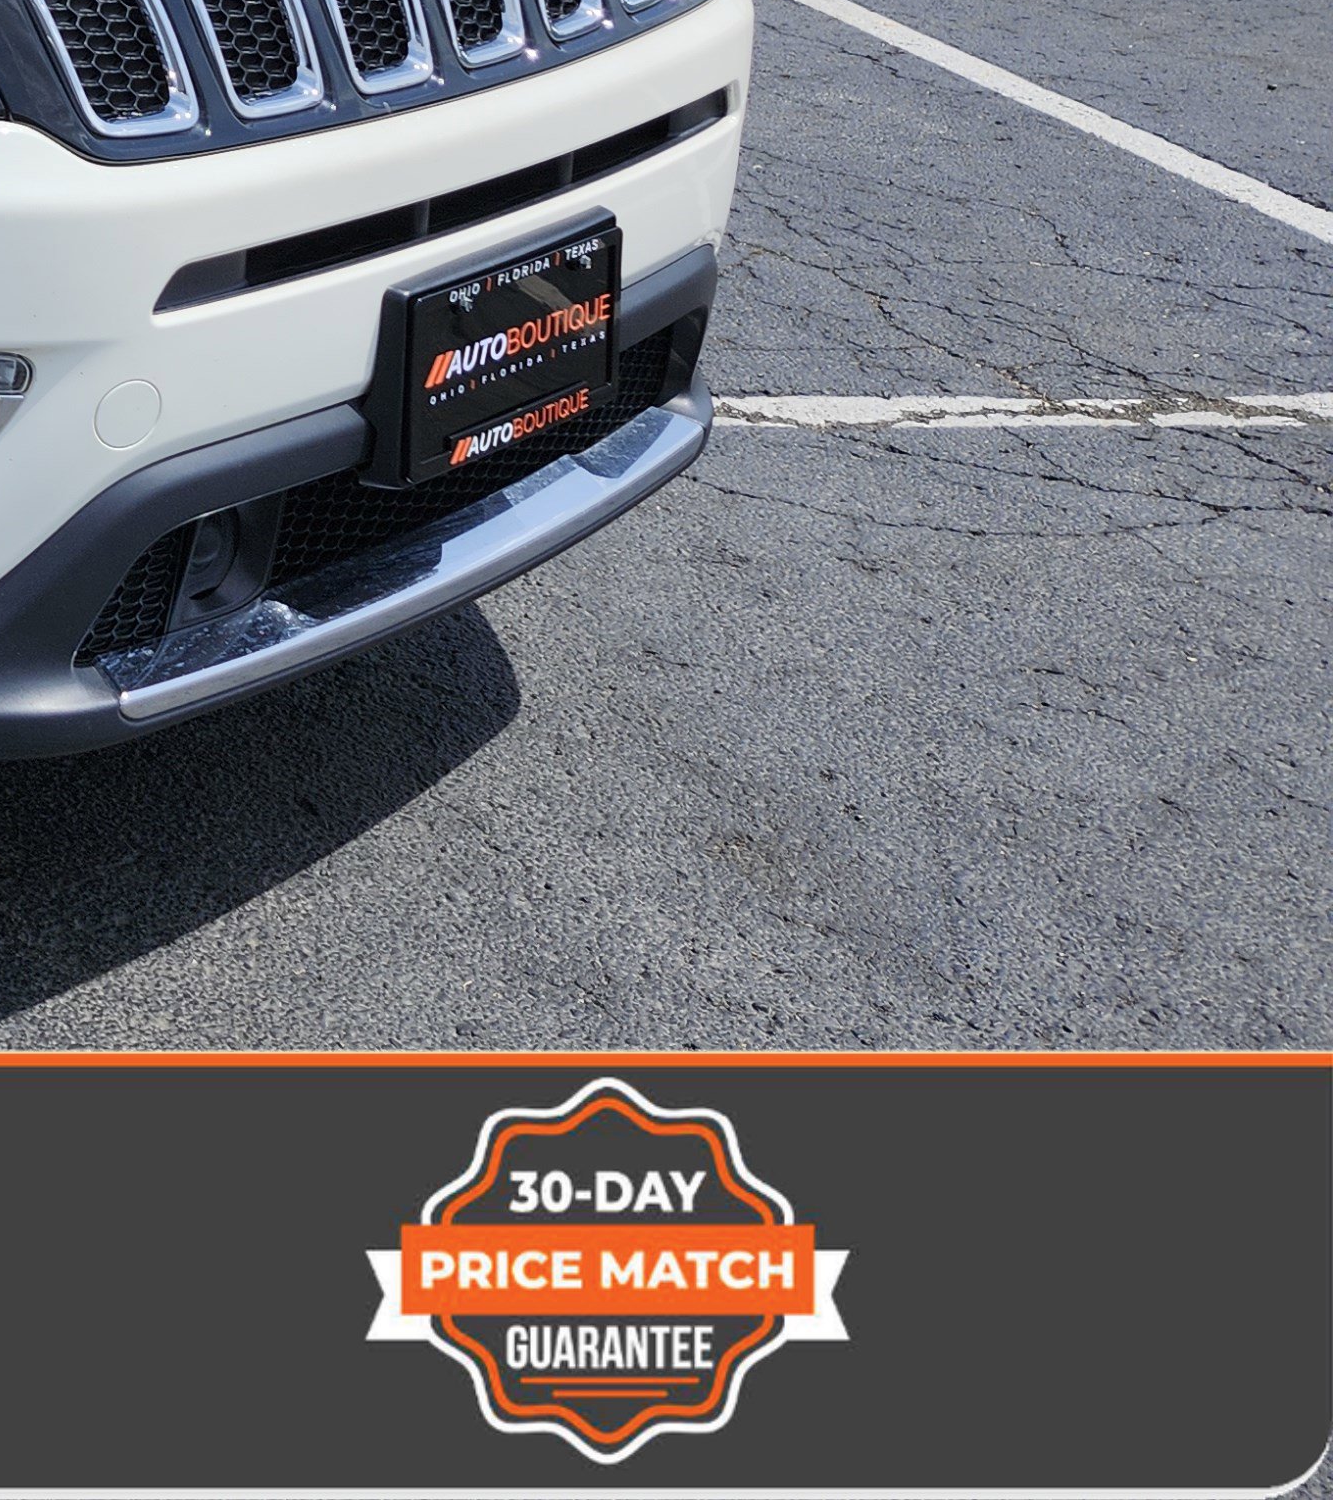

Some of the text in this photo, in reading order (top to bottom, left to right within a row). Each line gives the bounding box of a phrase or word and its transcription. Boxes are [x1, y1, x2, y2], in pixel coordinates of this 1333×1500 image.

[449, 238, 600, 304] OHIO FLORIDA TEXAS
[429, 330, 606, 406] OHIO FLORIDA TEXAS
